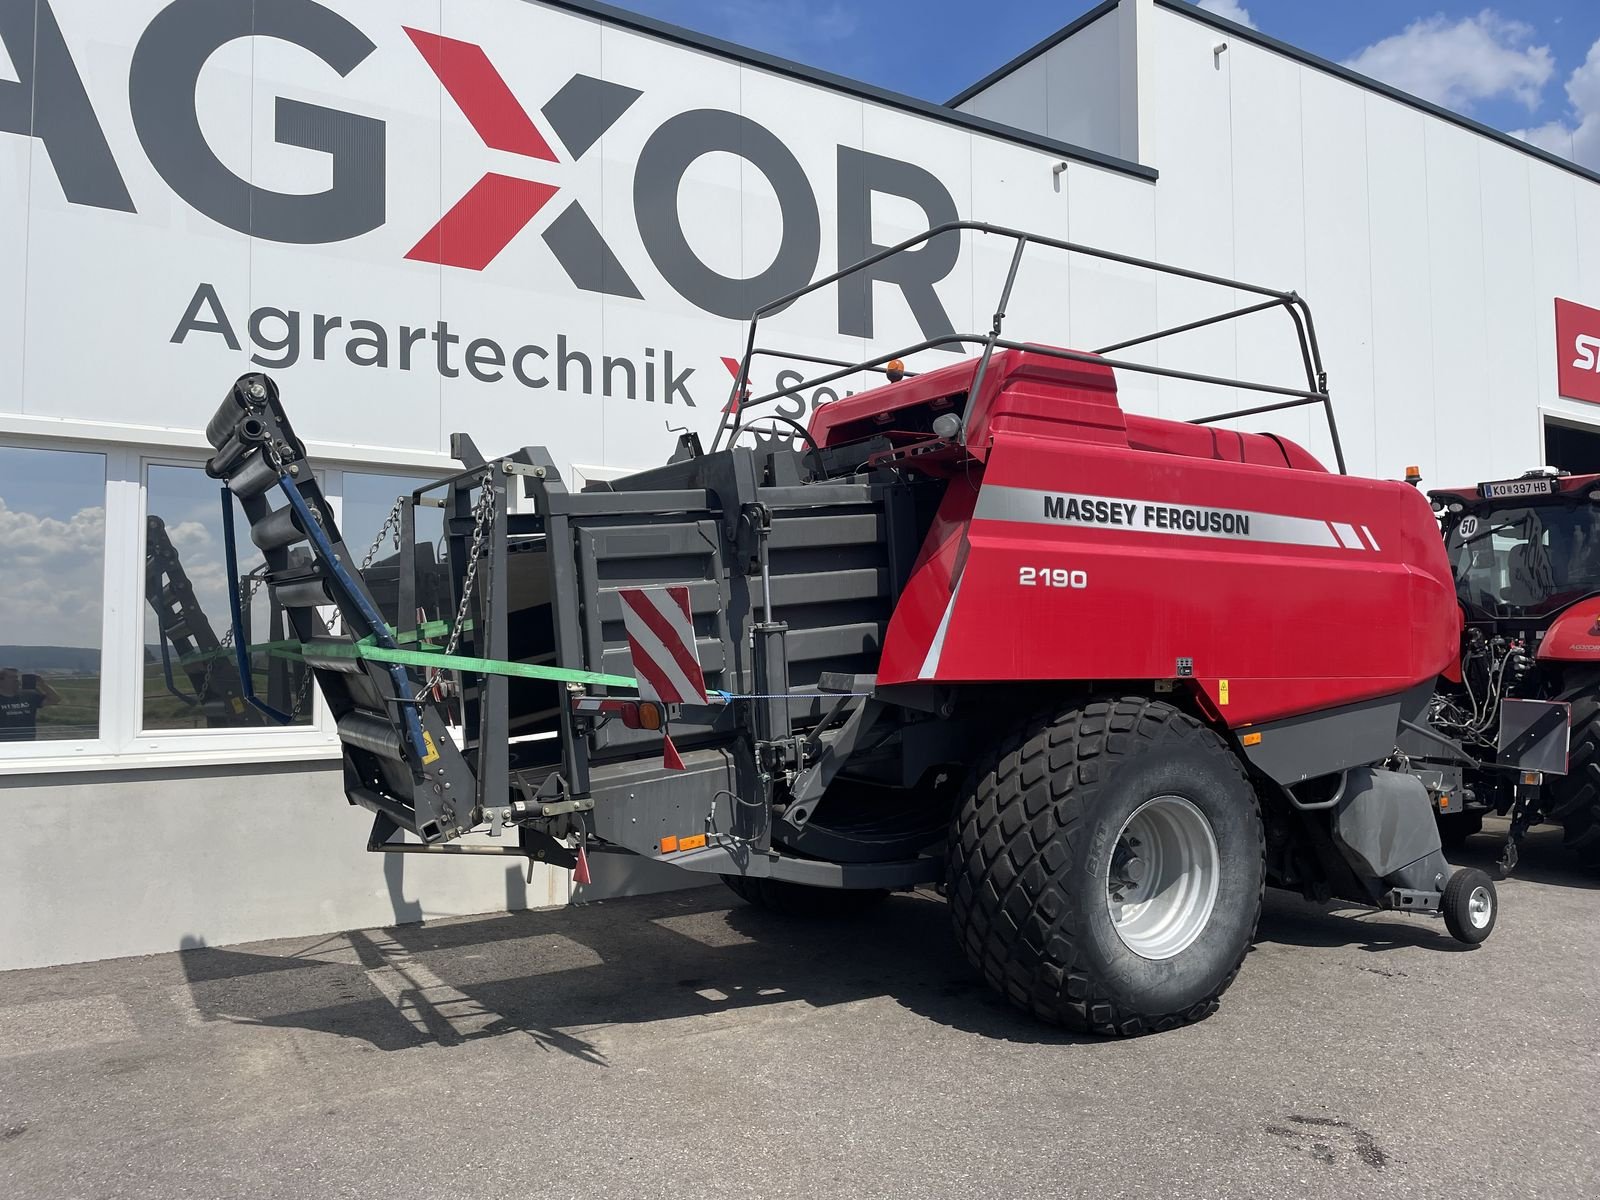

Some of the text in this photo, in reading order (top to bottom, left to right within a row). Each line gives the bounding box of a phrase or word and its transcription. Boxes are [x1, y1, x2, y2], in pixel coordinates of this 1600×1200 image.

[169, 282, 697, 408] Agrartechnik
[1572, 333, 1600, 373] S
[1513, 483, 1532, 494] 397
[1533, 481, 1547, 492] HB
[1043, 495, 1250, 536] MASSEY FERGUSON
[1461, 519, 1476, 535] 50
[1018, 566, 1088, 590] 2190
